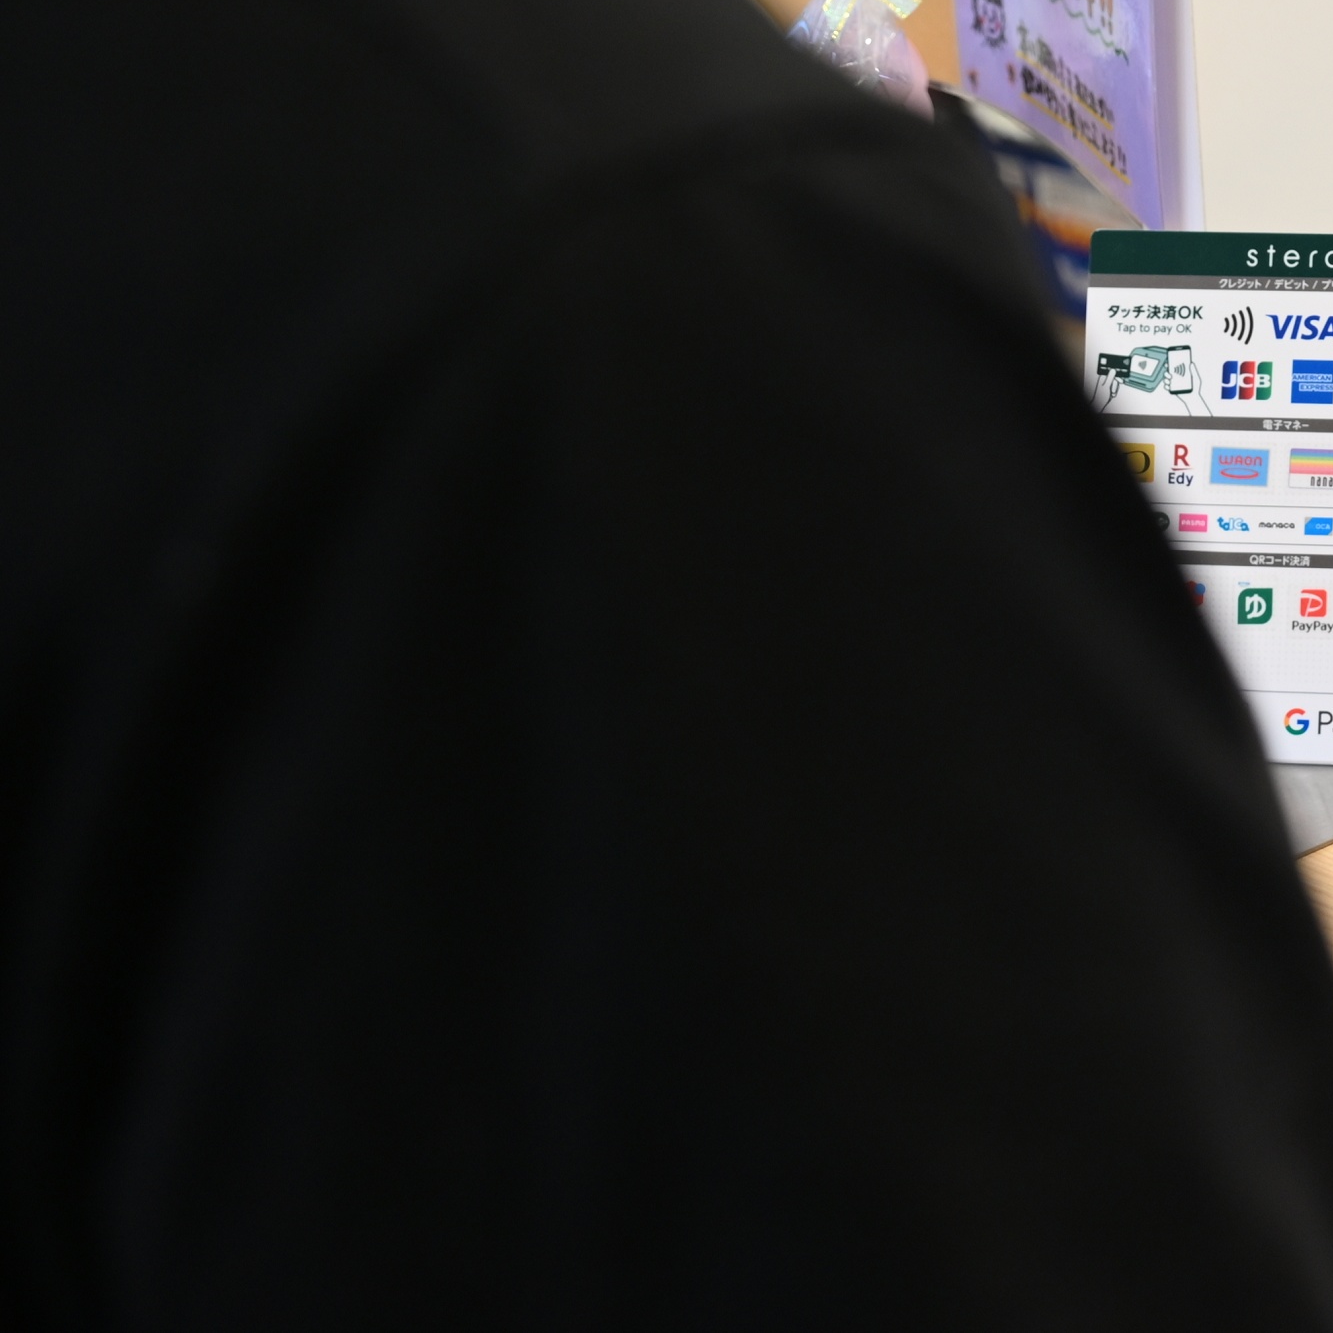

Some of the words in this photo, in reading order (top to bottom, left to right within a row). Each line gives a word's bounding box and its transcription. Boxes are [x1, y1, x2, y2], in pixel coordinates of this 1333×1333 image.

[1218, 278, 1262, 289] クレジット
[1274, 279, 1309, 289] デビット
[1107, 304, 1204, 320] タッチ決済OK
[1116, 323, 1133, 335] Tap
[1139, 323, 1150, 333] to
[1153, 323, 1172, 335] pay
[1175, 323, 1192, 334] OK
[1292, 373, 1331, 382] AMERICAN
[1300, 383, 1333, 392] EXPRESS
[1263, 419, 1310, 431] 電子マネー
[1218, 454, 1263, 467] WAON
[1168, 472, 1194, 486] Edy
[1258, 521, 1296, 529] manaca
[1249, 554, 1311, 566] QRコード決済
